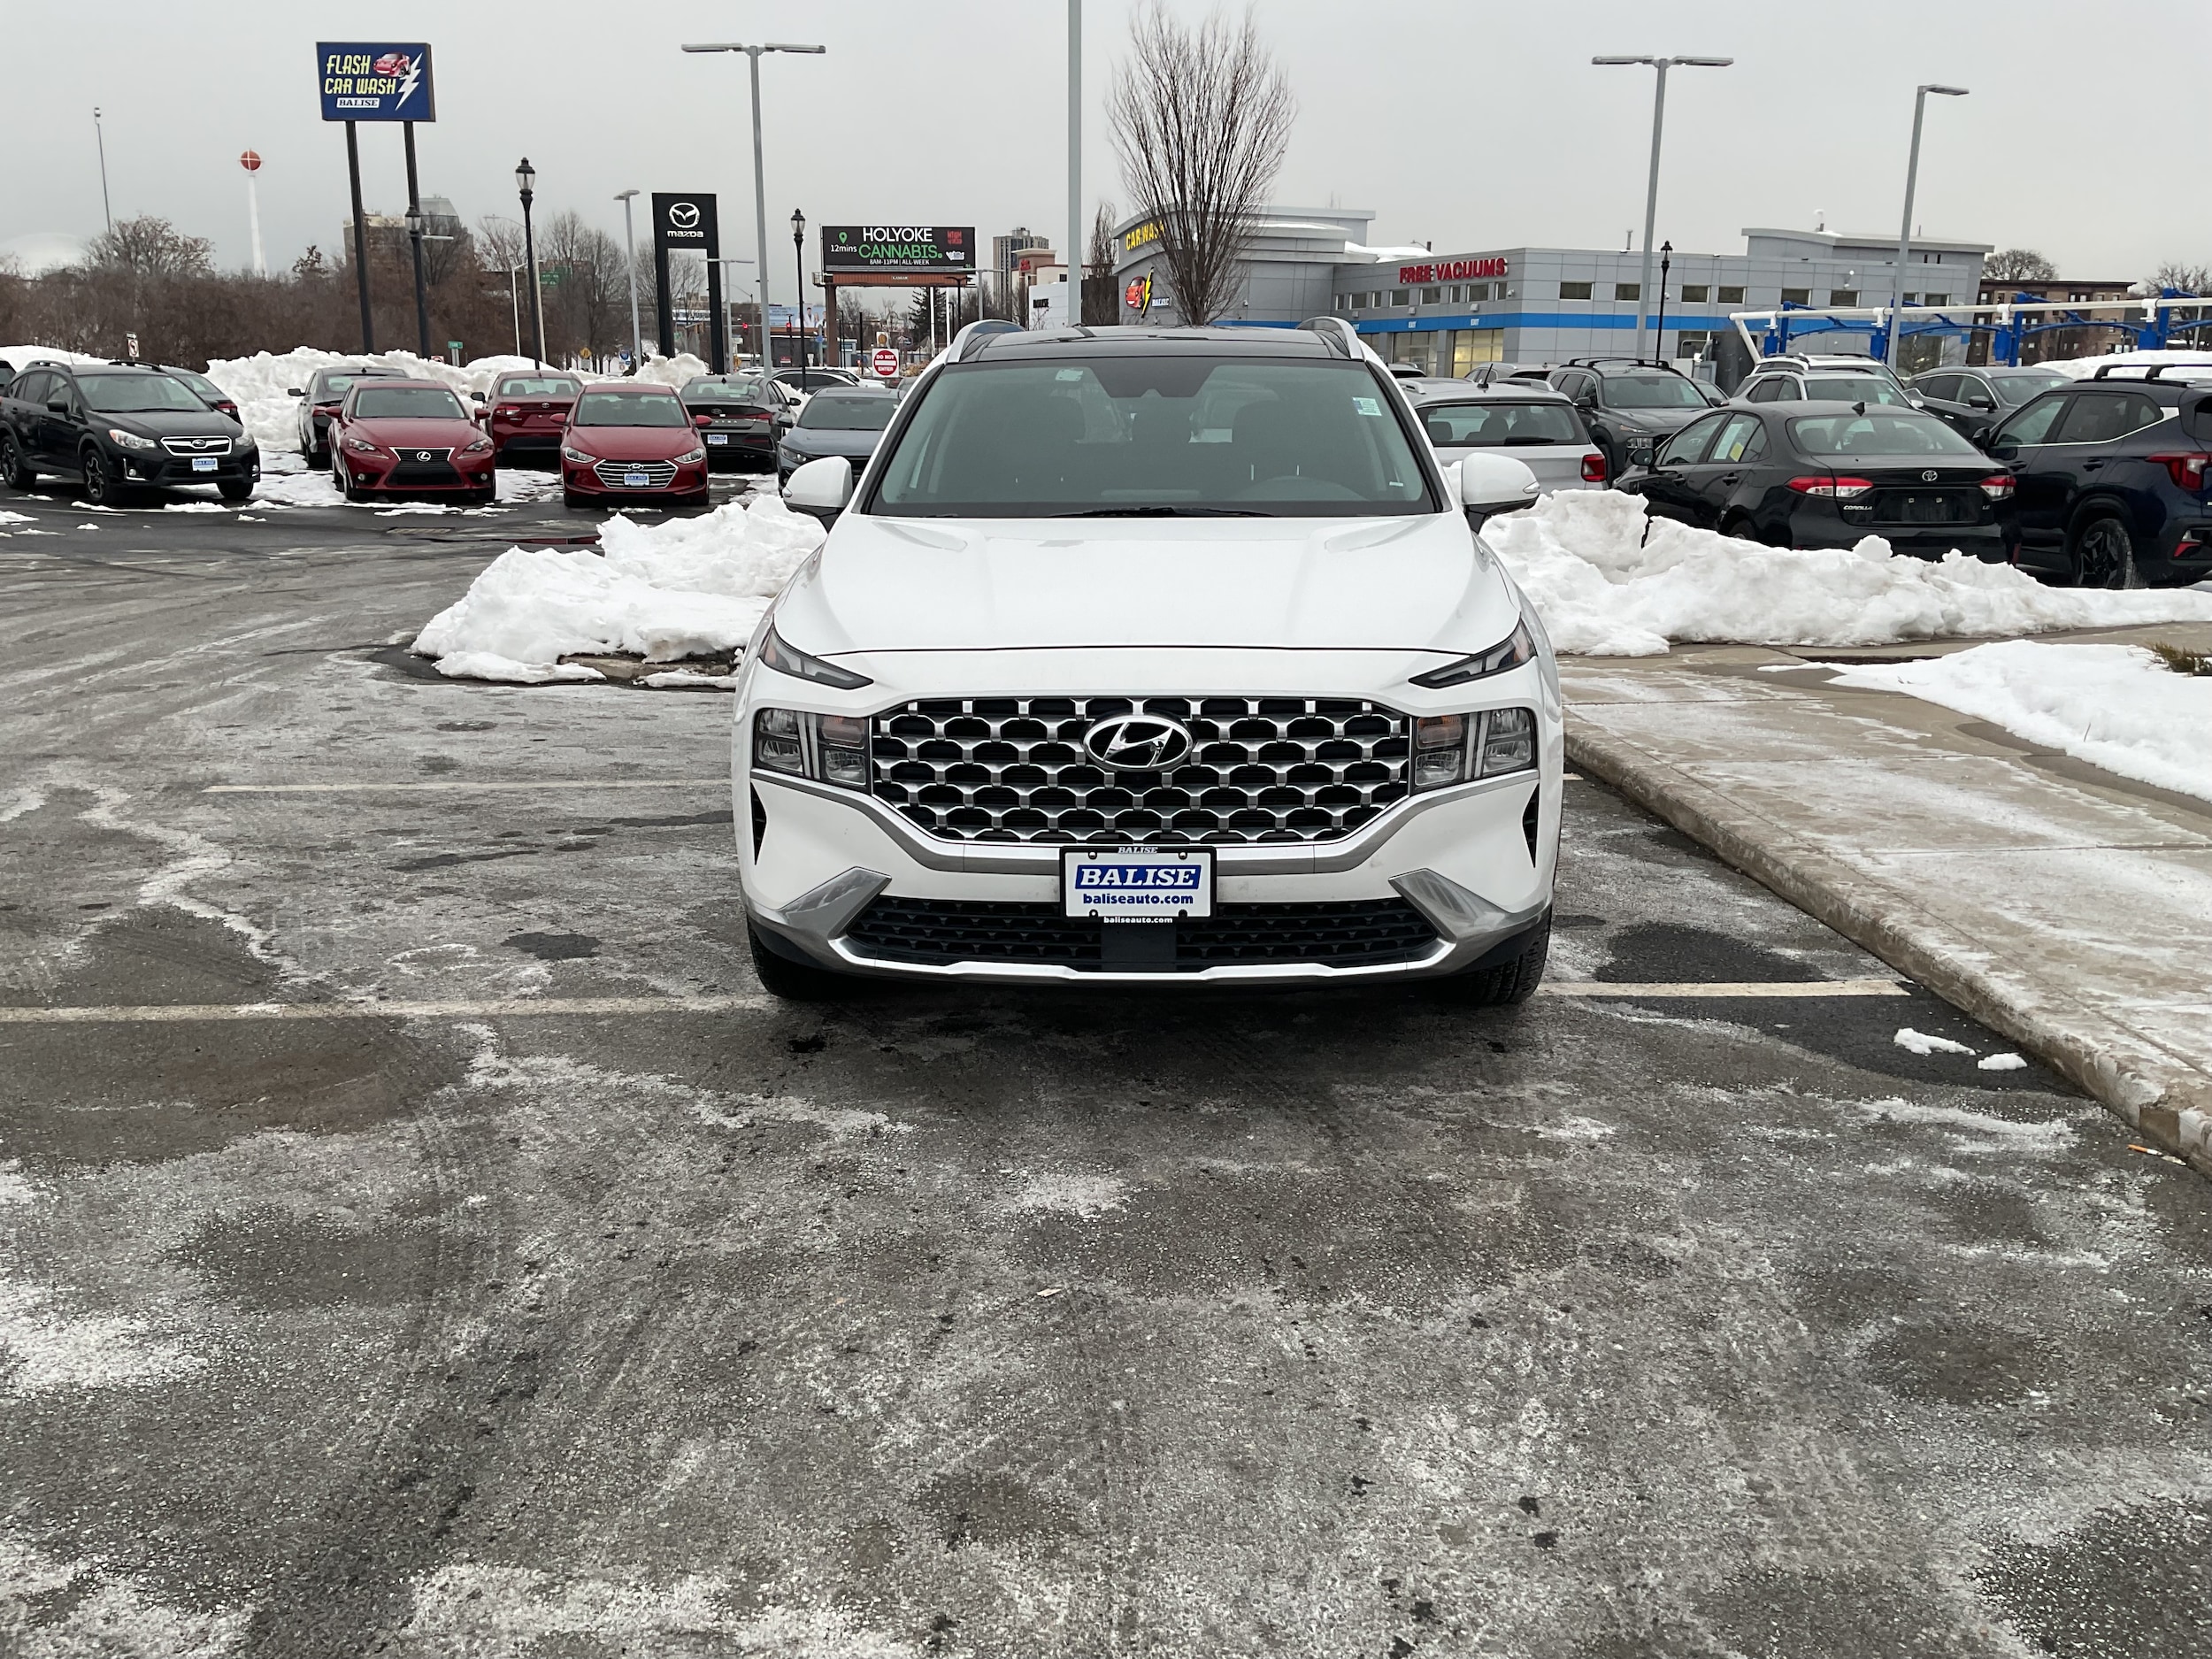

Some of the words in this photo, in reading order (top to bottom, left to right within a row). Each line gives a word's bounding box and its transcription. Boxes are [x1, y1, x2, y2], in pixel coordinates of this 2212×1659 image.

[326, 55, 371, 74] FLASH
[324, 78, 353, 95] CAR
[356, 78, 396, 95] WASH
[862, 227, 933, 242] HOLYOKE
[1125, 228, 1141, 251] CAR
[830, 244, 857, 253] 12mins
[1399, 265, 1434, 284] FREE
[1435, 257, 1508, 280] VACUUMS
[1080, 868, 1196, 886] BALISE
[1083, 893, 1194, 904] baliseauto.com
